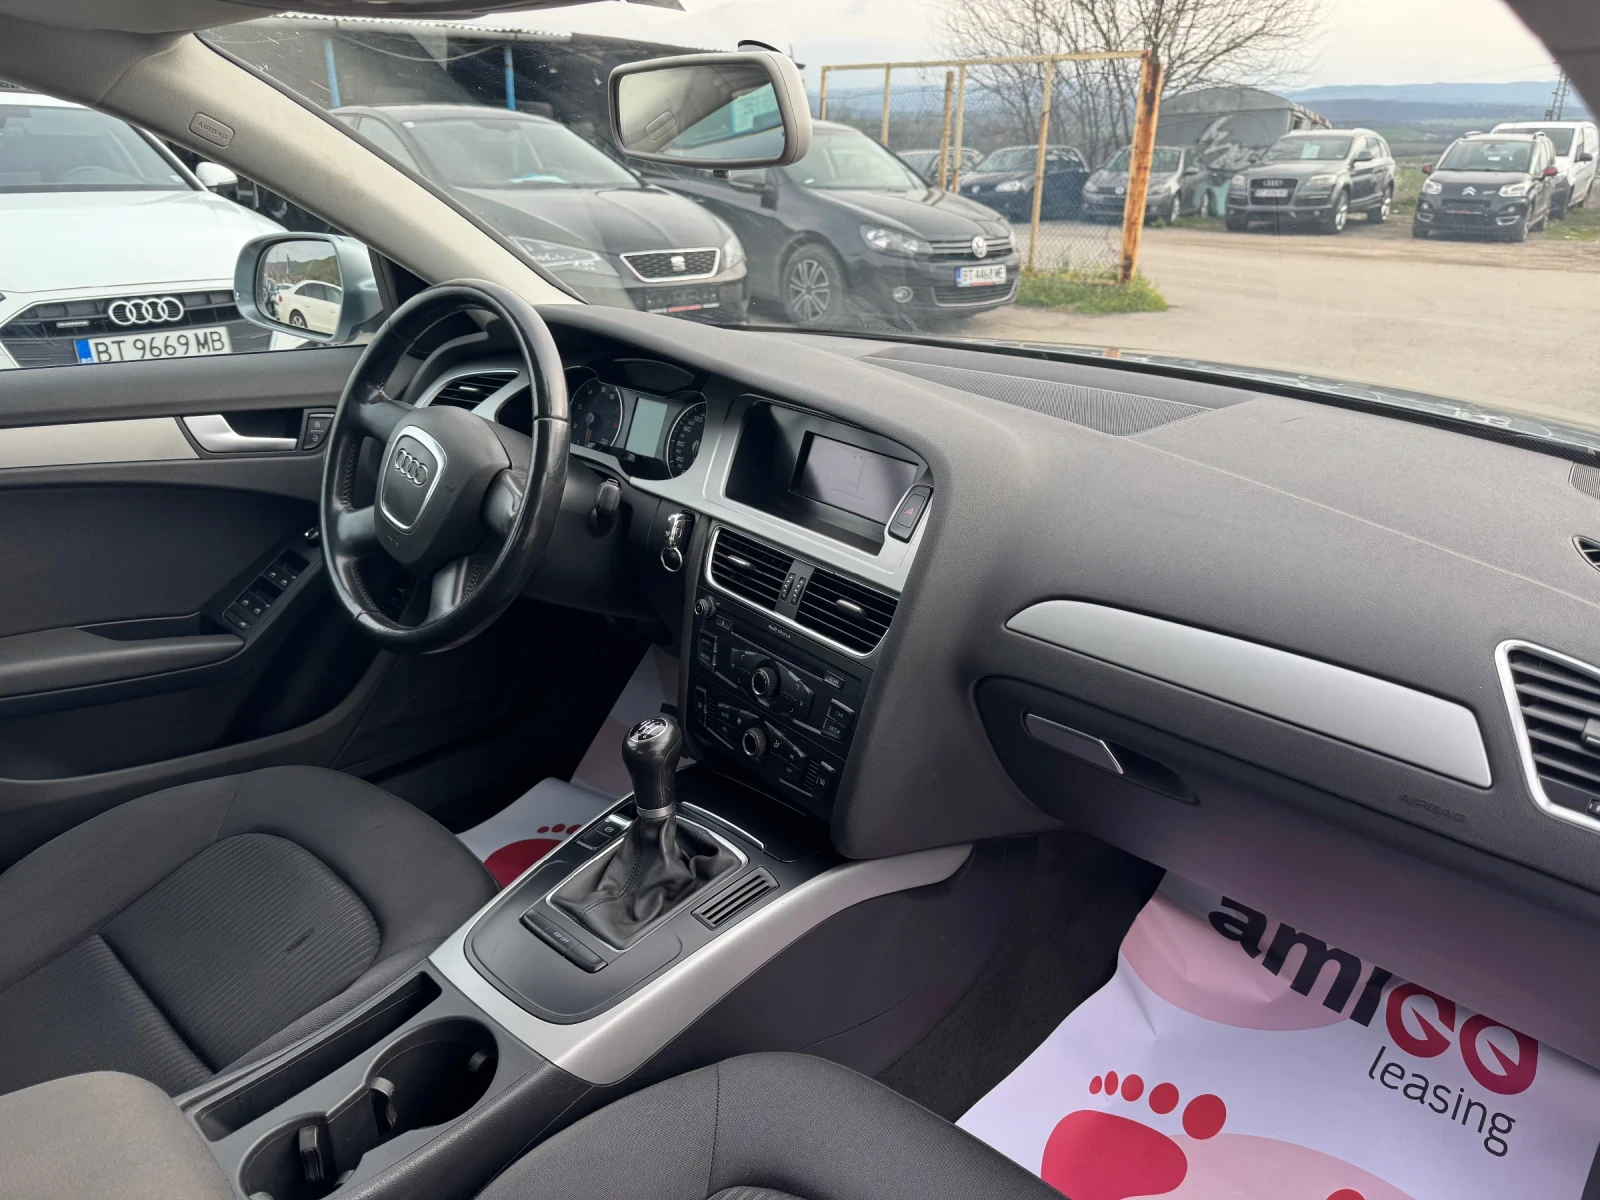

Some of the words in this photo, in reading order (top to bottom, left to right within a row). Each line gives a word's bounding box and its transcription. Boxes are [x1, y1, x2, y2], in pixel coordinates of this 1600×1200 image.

[197, 121, 229, 140] AIRBAG
[94, 340, 126, 362] BT
[133, 334, 189, 359] 9669
[194, 331, 225, 353] MB
[1368, 1045, 1516, 1158] leasing
